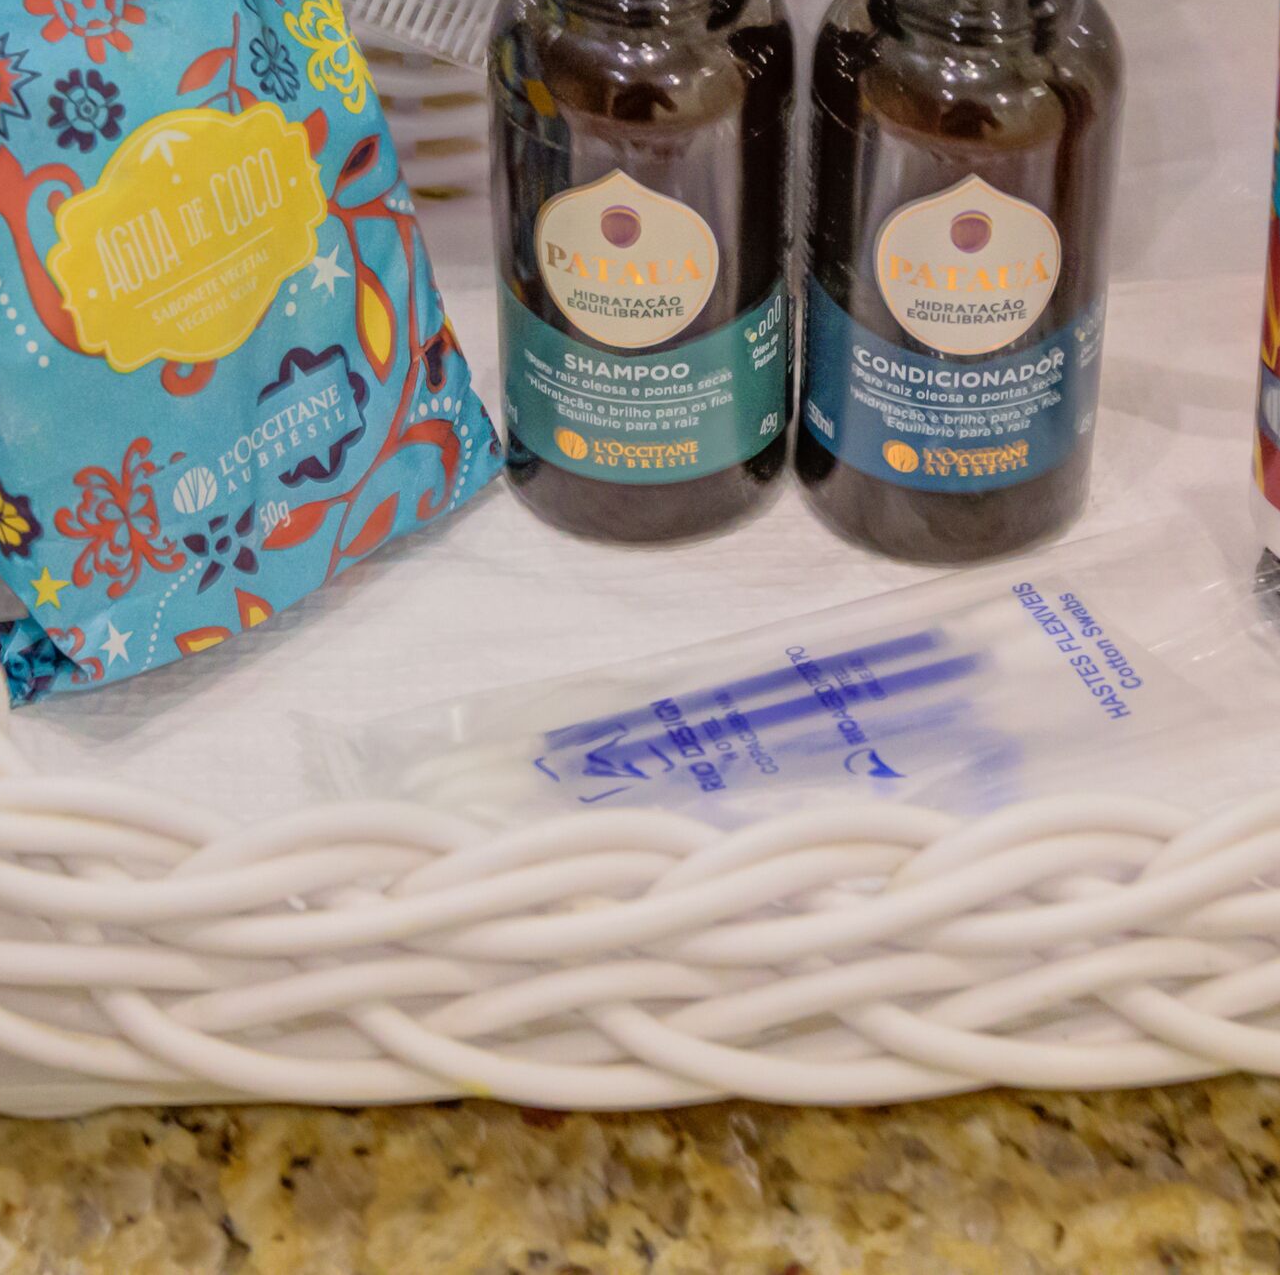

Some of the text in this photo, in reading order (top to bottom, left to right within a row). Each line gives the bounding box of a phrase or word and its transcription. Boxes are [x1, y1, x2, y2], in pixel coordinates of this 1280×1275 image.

[178, 196, 213, 247] DE
[209, 147, 284, 236] COCO
[544, 240, 705, 286] PATAUÁ
[888, 251, 1051, 293] PATAUÁ
[151, 247, 271, 326] SABONETE VEGETAL
[573, 288, 681, 310] HIDRATAÇÃO
[566, 297, 685, 319] EQUILIBRANTE
[906, 307, 1028, 325] EQUILIBRANTE
[914, 299, 1025, 315] HIDRATAÇÃO
[563, 352, 690, 382] SHAMPOO
[852, 346, 1065, 389] CONDICIONADOR
[555, 367, 579, 387] raiz
[581, 377, 628, 397] oleosa
[631, 386, 640, 397] e
[644, 383, 693, 398] pontas
[696, 368, 733, 391] secas
[885, 381, 912, 398] raiz
[915, 388, 964, 404] oleosa
[968, 393, 977, 404] e
[980, 386, 1029, 405] pontas
[597, 404, 606, 414] e
[609, 405, 651, 419] brilho
[655, 405, 687, 420] para
[691, 402, 707, 414] os
[710, 389, 734, 408] fios
[943, 409, 986, 425] brilho
[990, 408, 1021, 426] para
[625, 420, 658, 432] para
[661, 420, 670, 430] a
[674, 414, 700, 429] raiz
[760, 411, 778, 435] 49g
[959, 424, 992, 440] para
[1006, 418, 1032, 431] raiz
[594, 454, 619, 467] AU
[226, 468, 252, 495] AU
[258, 500, 292, 533] 50g
[1058, 592, 1144, 690] Cotton Swabs
[1069, 654, 1133, 720] HASTES
